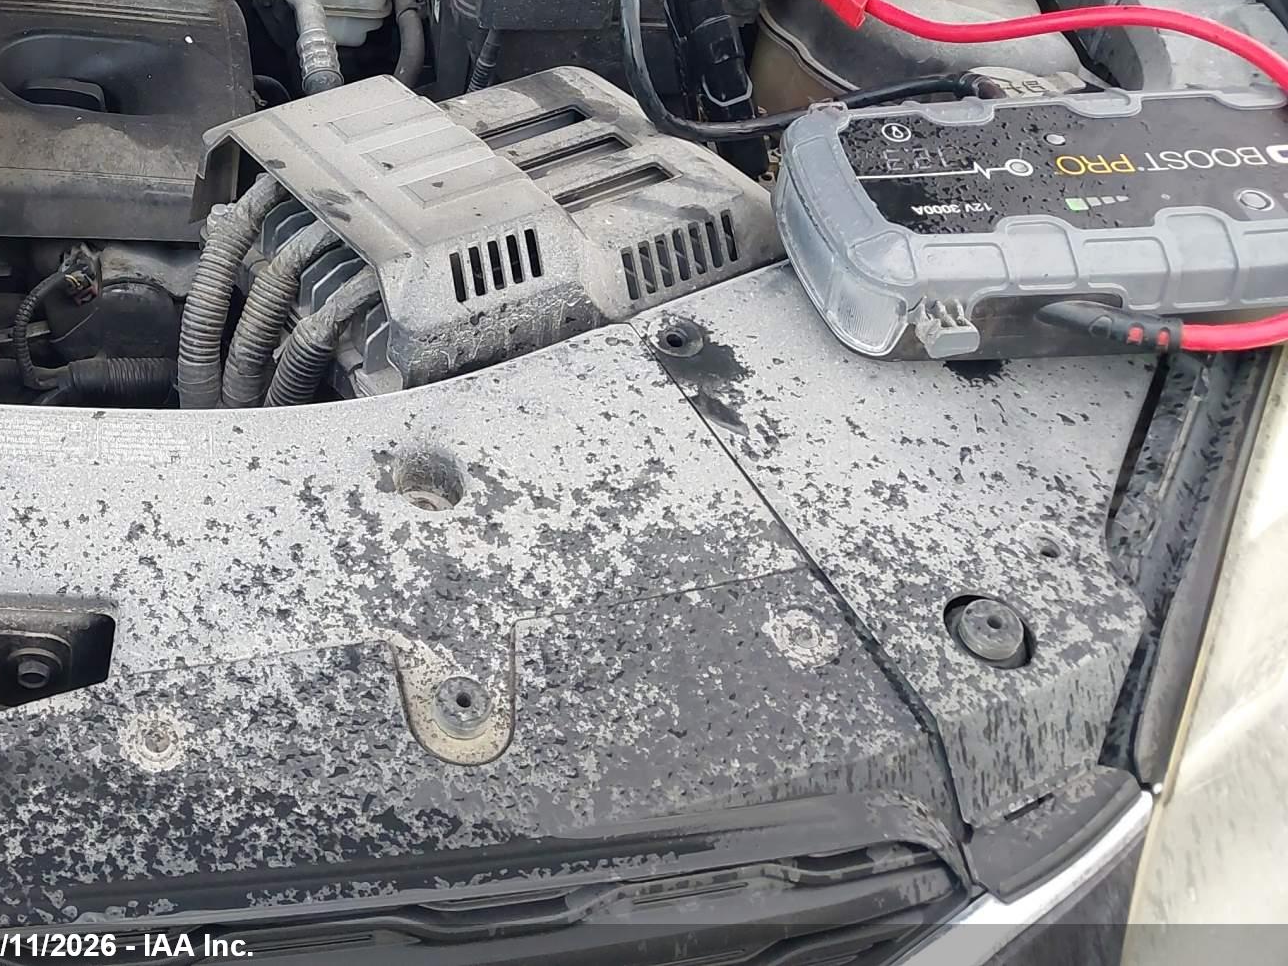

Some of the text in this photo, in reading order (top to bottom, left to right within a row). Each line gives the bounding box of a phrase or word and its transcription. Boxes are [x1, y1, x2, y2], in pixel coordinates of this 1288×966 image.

[1055, 153, 1136, 176] PRO
[1143, 146, 1268, 172] BOOST
[911, 201, 993, 216] 12V 3000A
